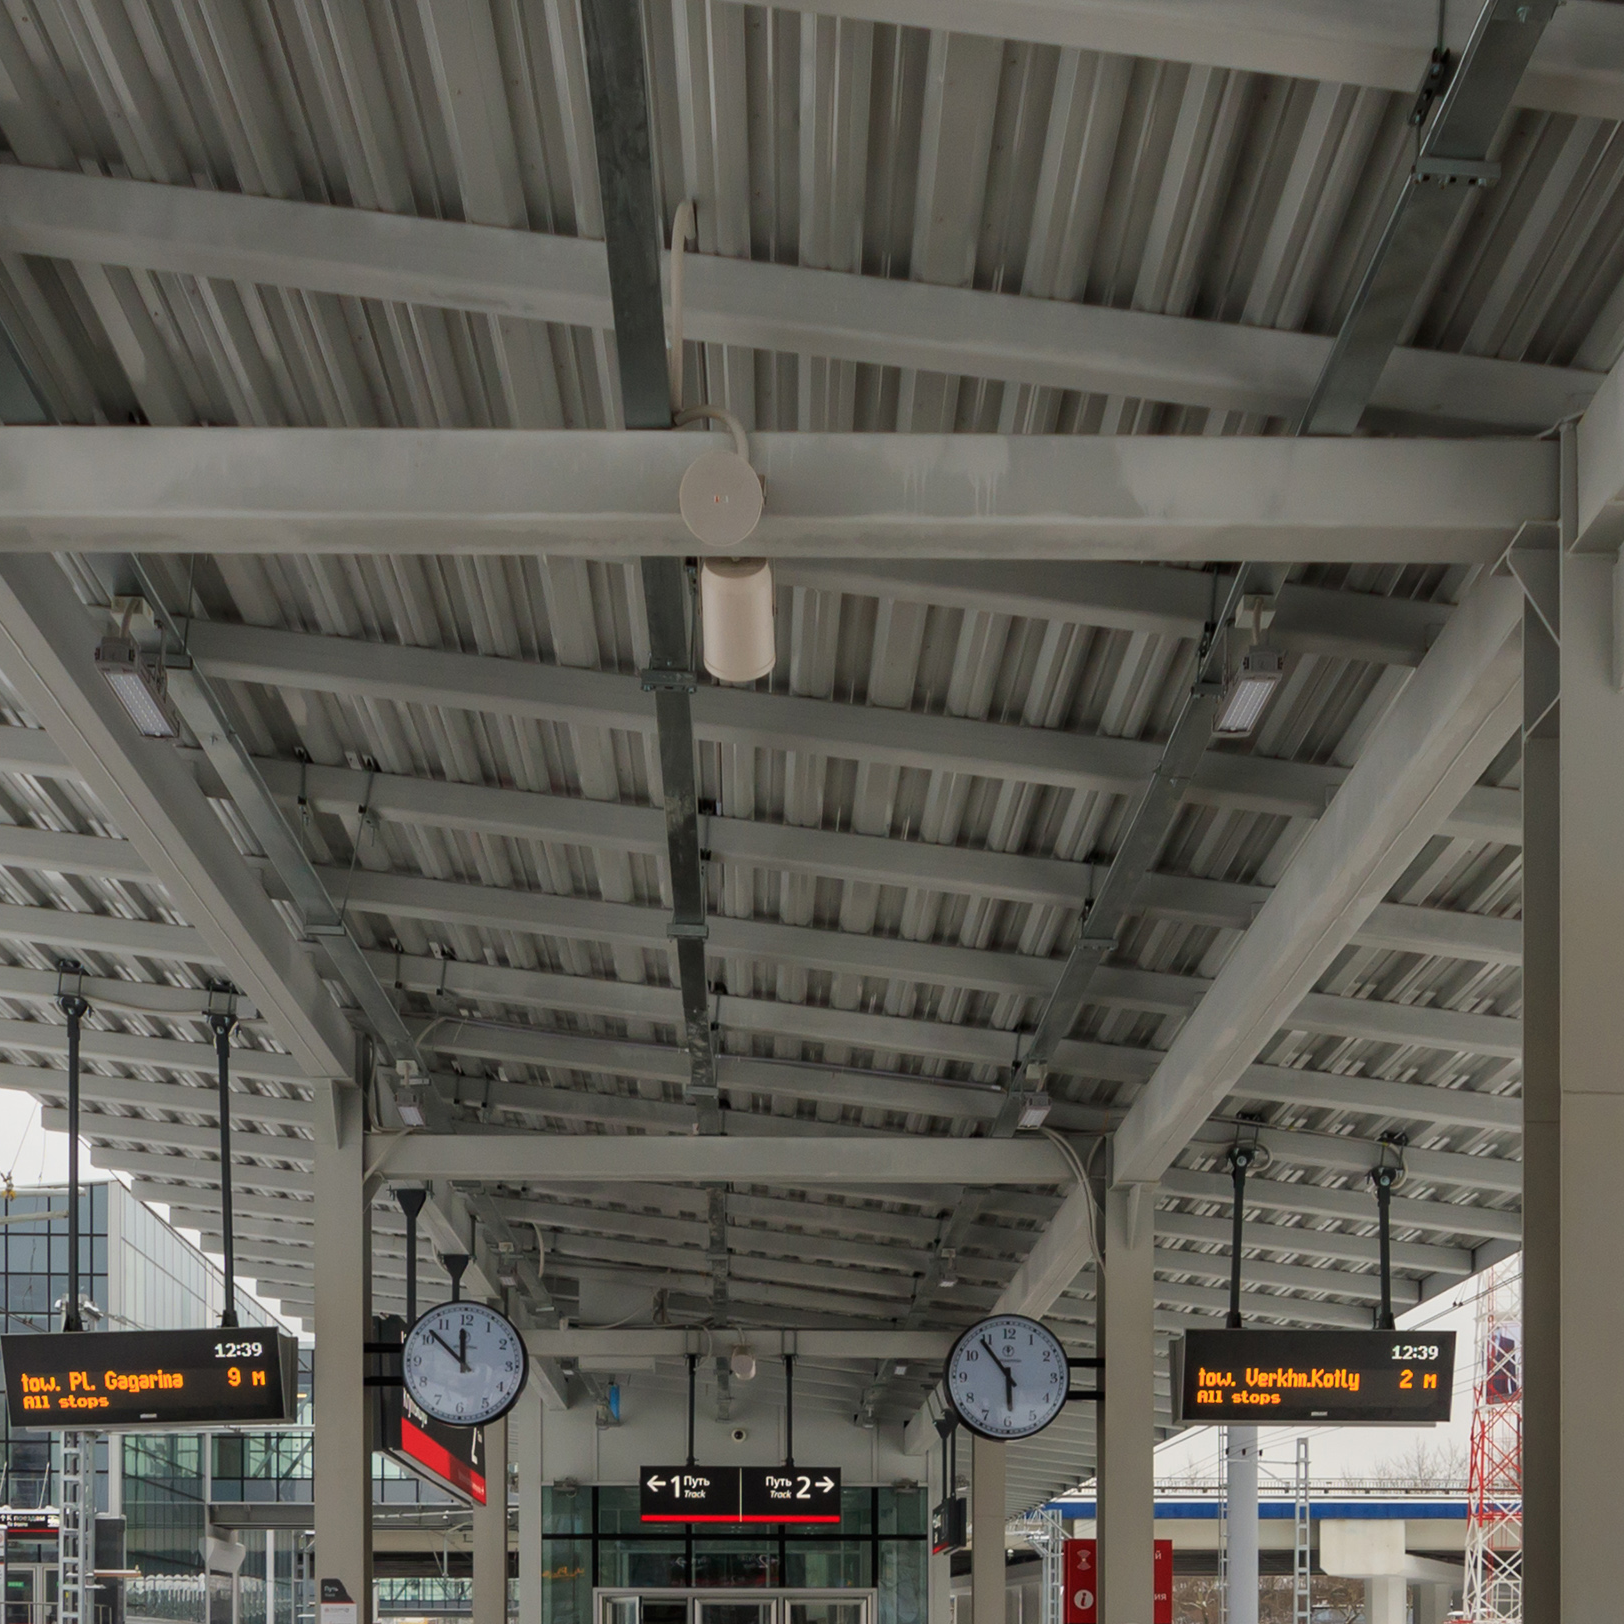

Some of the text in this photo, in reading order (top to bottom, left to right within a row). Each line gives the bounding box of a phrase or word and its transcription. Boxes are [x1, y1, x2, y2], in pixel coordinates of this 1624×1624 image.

[439, 1319, 449, 1330] 11
[461, 1314, 474, 1326] 12
[486, 1322, 491, 1333] 1
[1003, 1328, 1016, 1340] 12
[1028, 1334, 1034, 1345] 1
[214, 1342, 263, 1358] 12:39
[499, 1339, 508, 1350] 2
[966, 1350, 978, 1361] 10
[1042, 1351, 1051, 1362] 2
[1391, 1345, 1439, 1360] 12:39
[413, 1355, 422, 1367] 9
[505, 1361, 513, 1373] 3
[21, 1373, 61, 1393] tow.
[69, 1371, 96, 1391] Pl.
[104, 1369, 184, 1393] Gagarina
[227, 1366, 241, 1387] 9
[419, 1377, 428, 1387] 8
[959, 1372, 968, 1383] 9
[1050, 1372, 1058, 1384] 3
[1198, 1367, 1236, 1387] tow.
[1245, 1367, 1360, 1392] Verkhn.Kotly
[1399, 1369, 1413, 1389] 2
[496, 1381, 504, 1392] 4
[23, 1394, 109, 1410] All stops
[434, 1394, 442, 1405] 7
[481, 1397, 490, 1408] 5
[966, 1392, 975, 1403] 8
[1043, 1393, 1049, 1403] 4
[1197, 1389, 1281, 1406] All stops
[455, 1402, 464, 1414] 6
[981, 1409, 989, 1421] 7
[1029, 1410, 1037, 1421] 5
[1004, 1416, 1012, 1427] 6
[670, 1475, 710, 1498] 1 Путь
[765, 1476, 811, 1499] Путь 2
[684, 1489, 706, 1499] Track
[770, 1490, 792, 1499] Track
